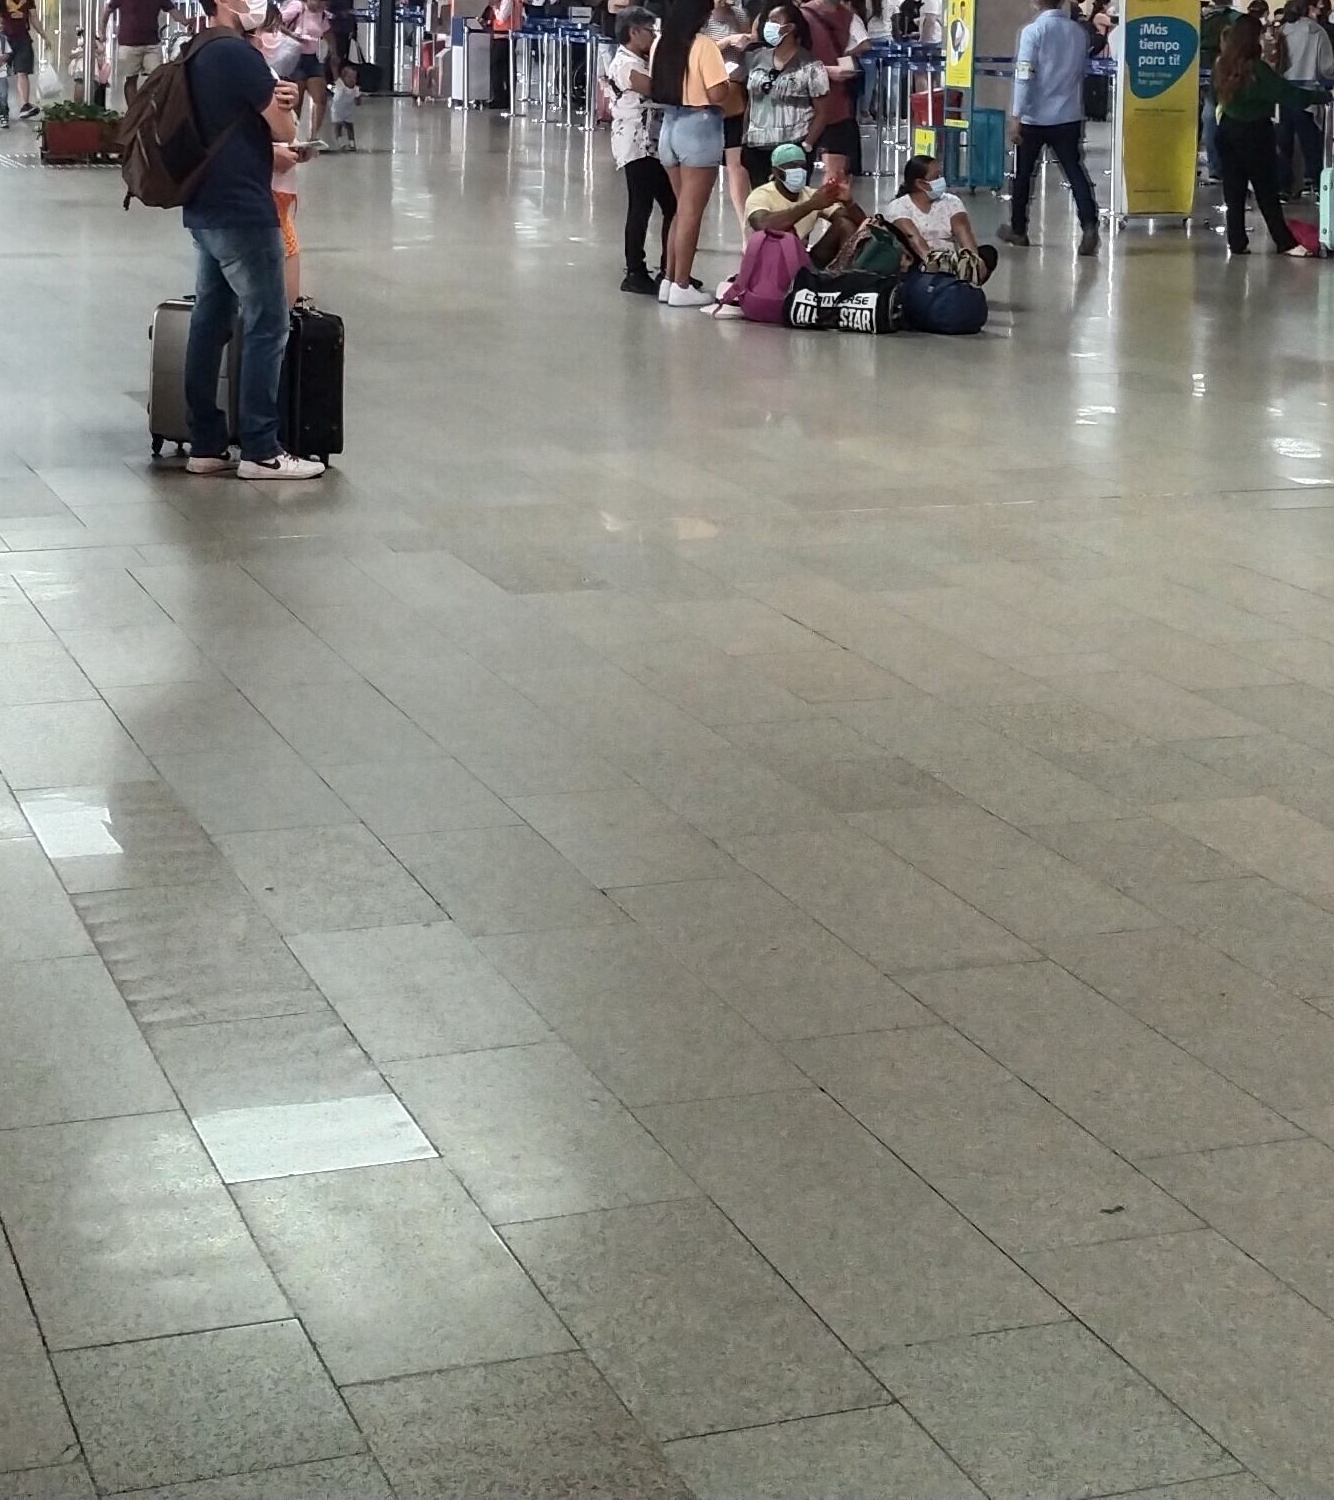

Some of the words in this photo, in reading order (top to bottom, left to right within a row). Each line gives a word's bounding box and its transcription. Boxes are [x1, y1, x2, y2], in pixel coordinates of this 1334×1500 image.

[1138, 38, 1180, 52] tiempo
[1138, 55, 1166, 67] para
[1169, 54, 1181, 66] ti!
[839, 307, 872, 331] STAR
